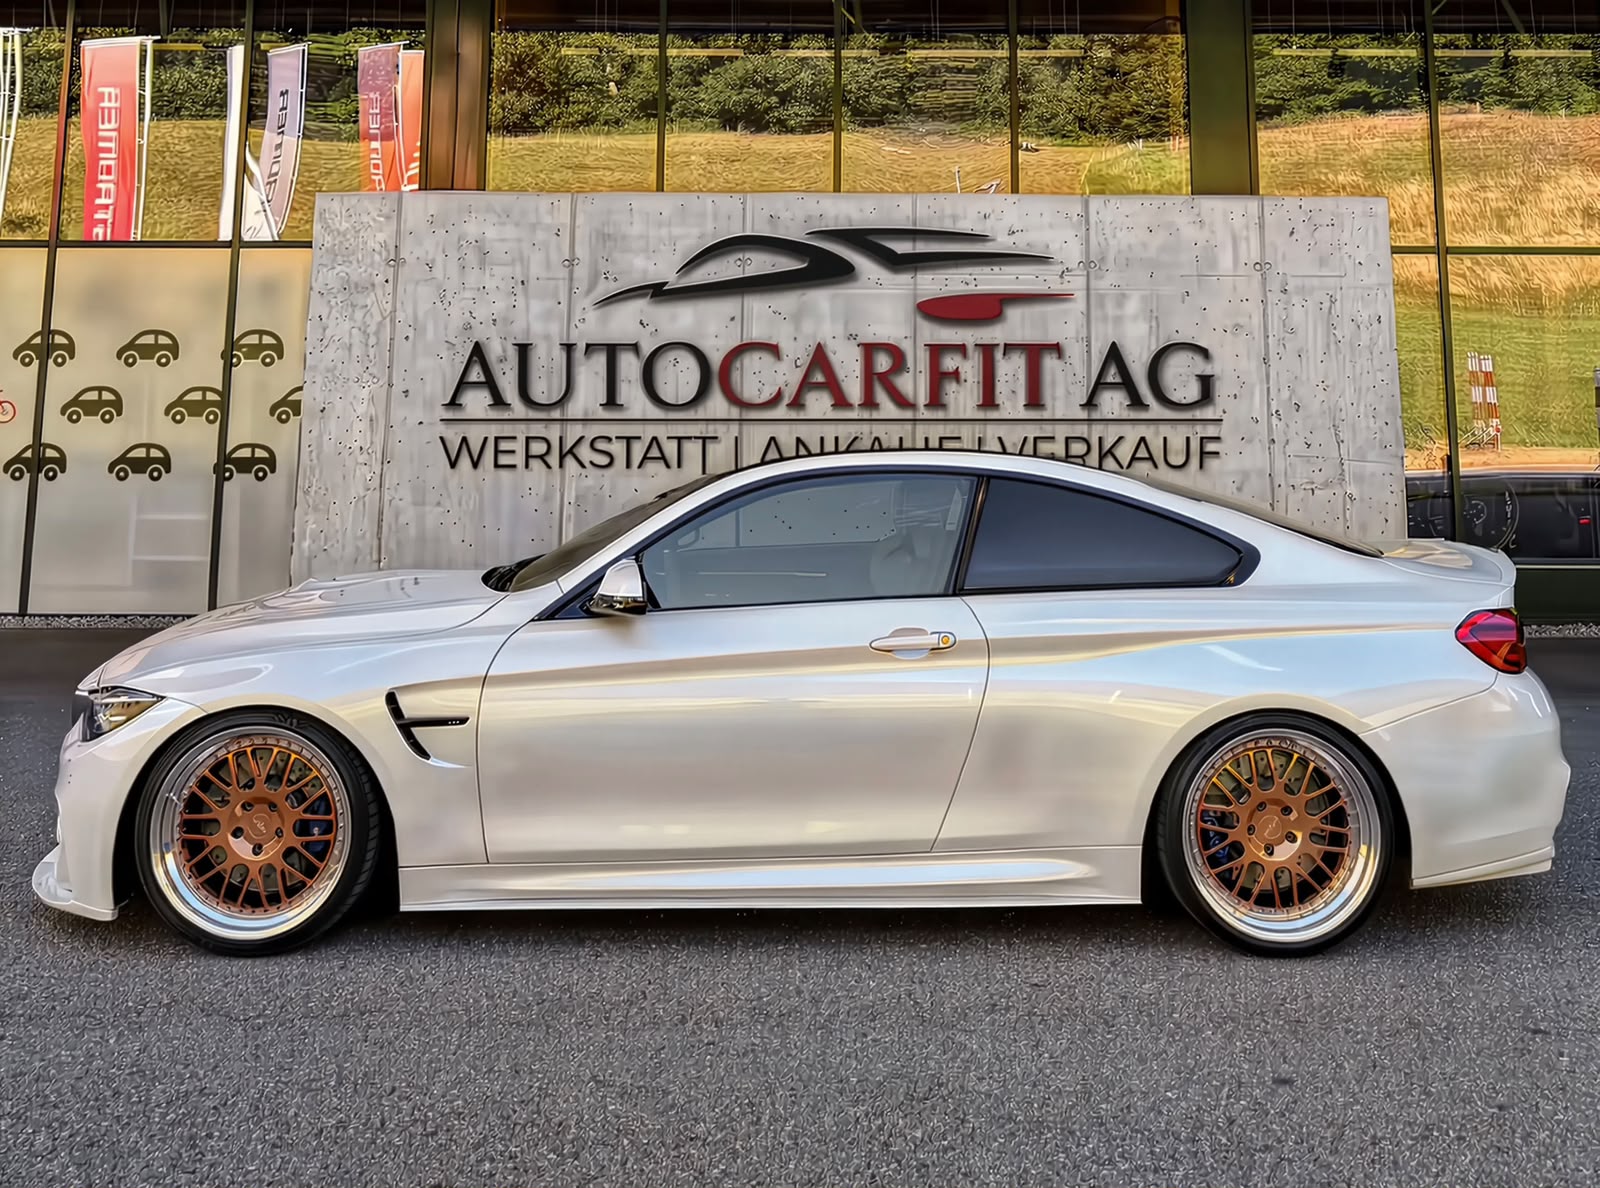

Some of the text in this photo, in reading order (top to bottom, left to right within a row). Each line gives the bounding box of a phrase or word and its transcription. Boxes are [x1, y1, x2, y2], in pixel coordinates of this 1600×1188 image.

[441, 340, 1215, 409] AUTOCARFIT AG
[439, 435, 719, 473] WERKSTATT
[997, 436, 1222, 470] VERKAUF
